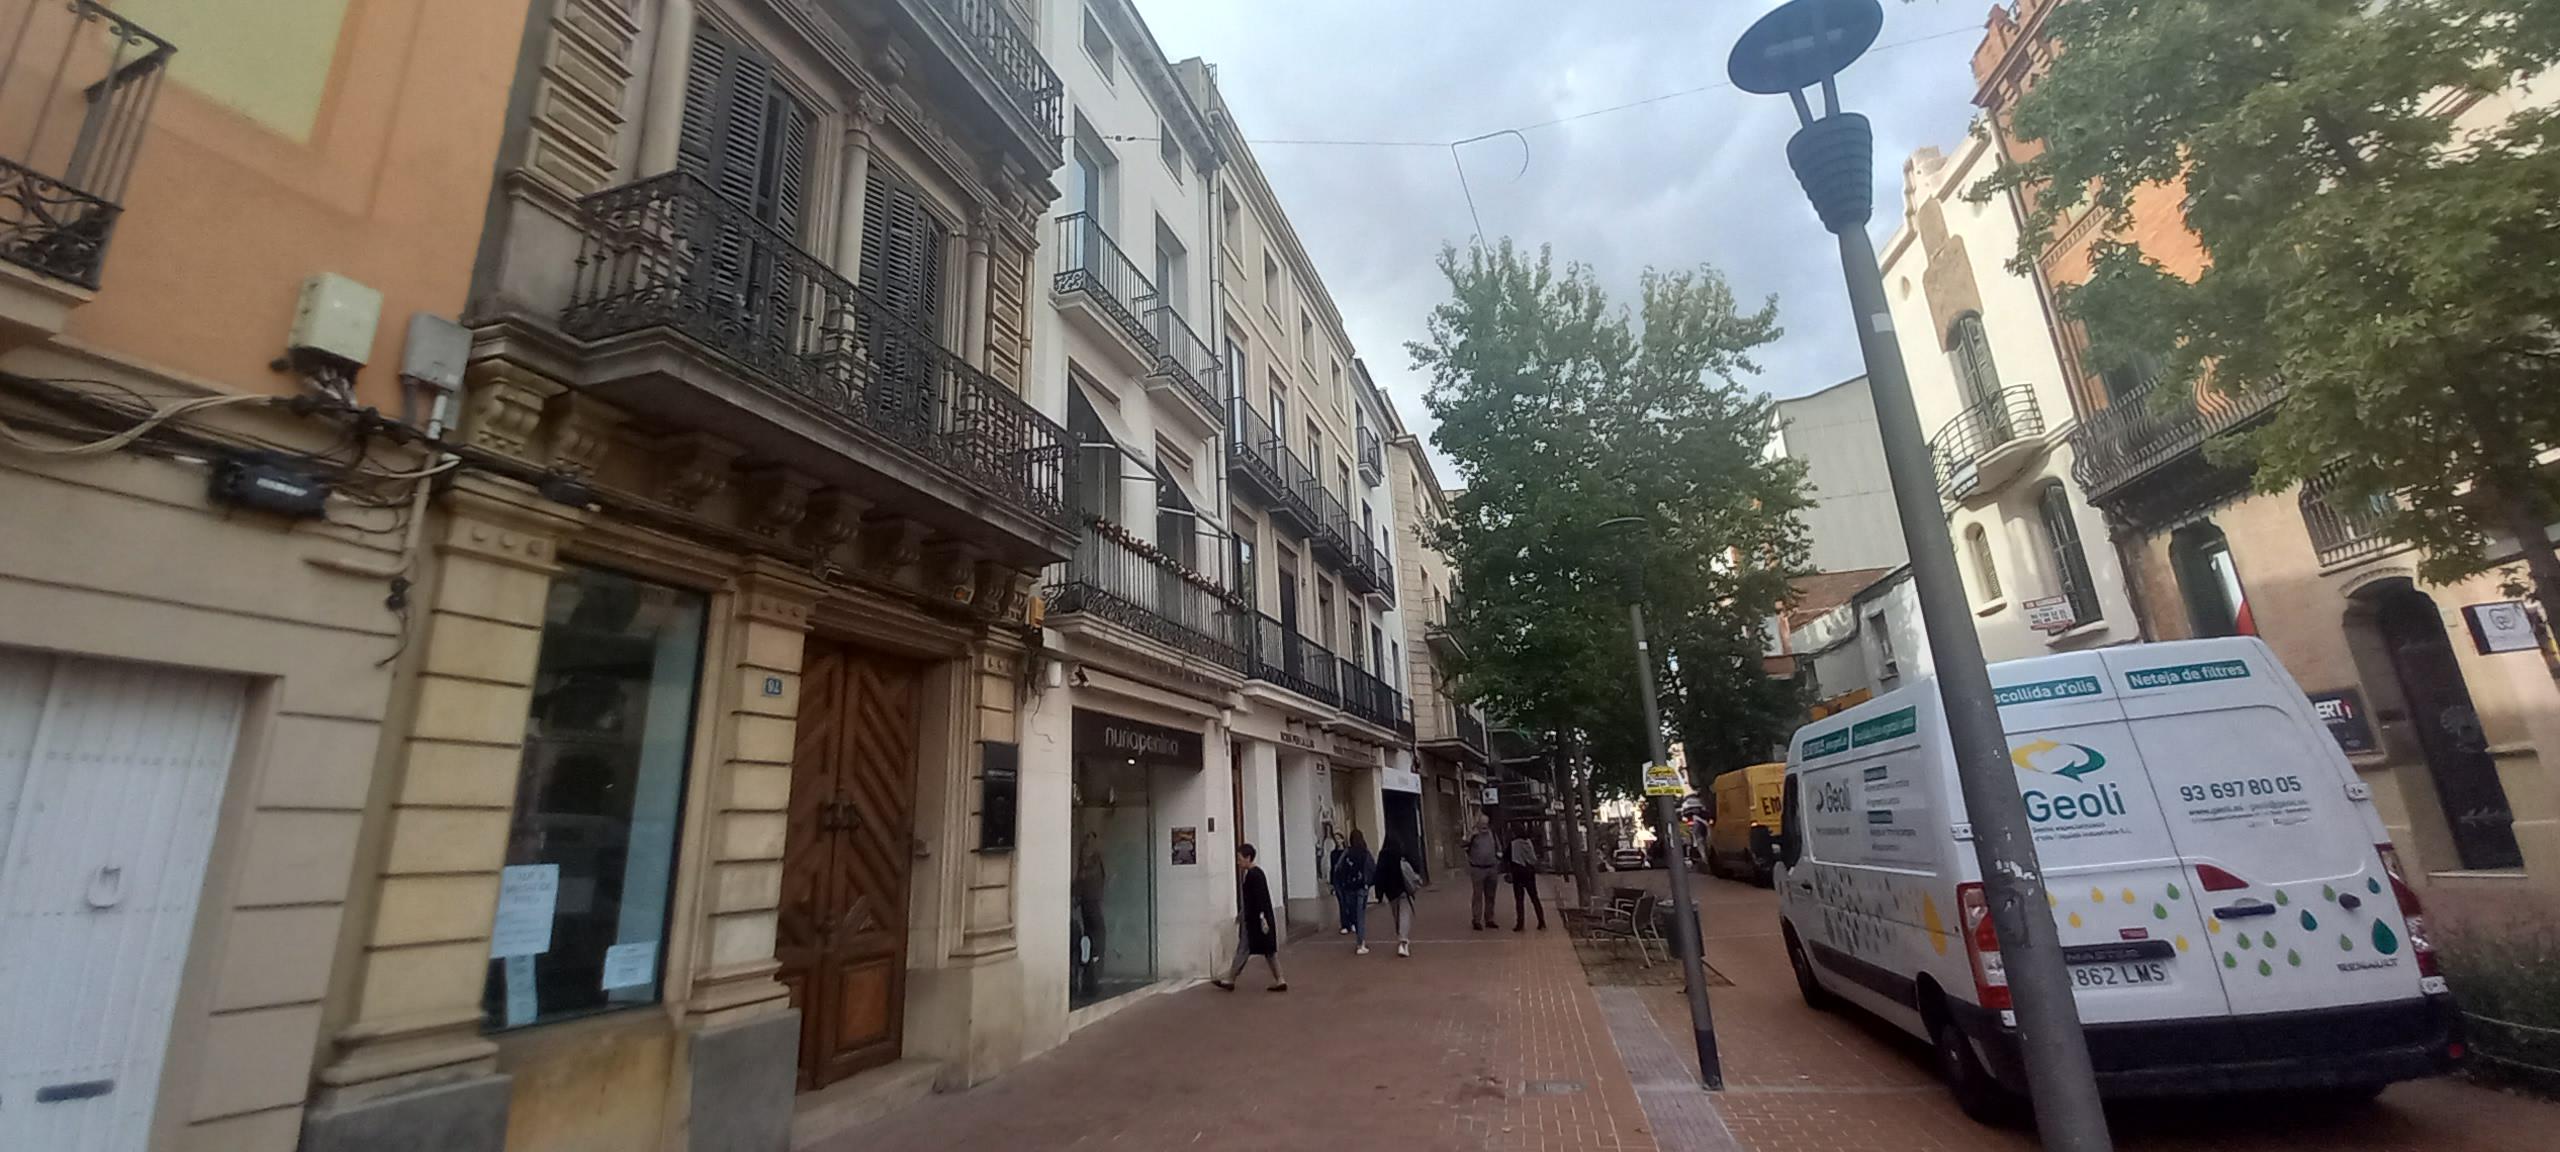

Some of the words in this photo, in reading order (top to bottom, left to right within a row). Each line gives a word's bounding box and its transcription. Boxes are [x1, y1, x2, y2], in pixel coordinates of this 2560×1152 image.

[2129, 672, 2179, 687] Neteja
[2181, 669, 2200, 681] de
[2201, 664, 2247, 679] filtres
[1994, 685, 2052, 704] ecollida
[2055, 680, 2097, 696] d'olis
[2315, 700, 2343, 719] ERT
[2180, 785, 2206, 802] 93
[2210, 780, 2244, 799] 697
[2248, 778, 2274, 795] 80
[2275, 775, 2302, 793] 05
[1761, 796, 1782, 815] EM
[2023, 782, 2127, 823] Geoli
[2076, 967, 2118, 987] 862
[2121, 961, 2165, 984] LMS
